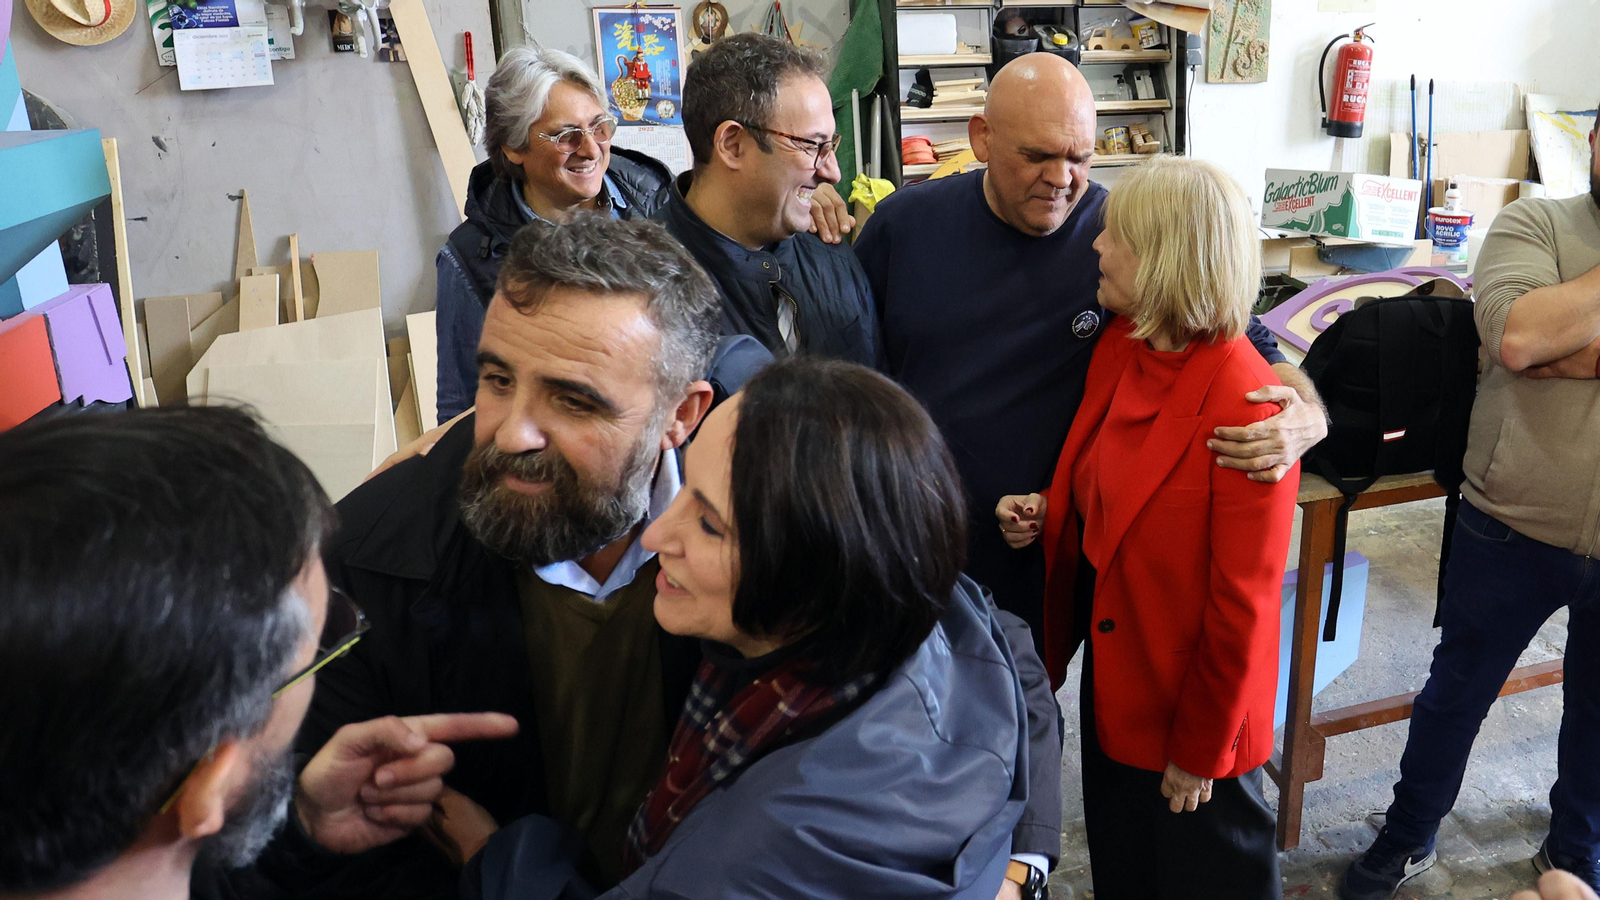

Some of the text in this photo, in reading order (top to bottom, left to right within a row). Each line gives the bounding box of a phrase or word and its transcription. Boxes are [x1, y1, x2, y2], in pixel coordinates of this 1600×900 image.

[1343, 94, 1366, 103] RUCA
[1264, 172, 1339, 204] GalacticBlum
[1376, 183, 1419, 202] EXCELLENT
[1285, 195, 1316, 213] EXCELLENT
[1435, 216, 1462, 224] eurotex
